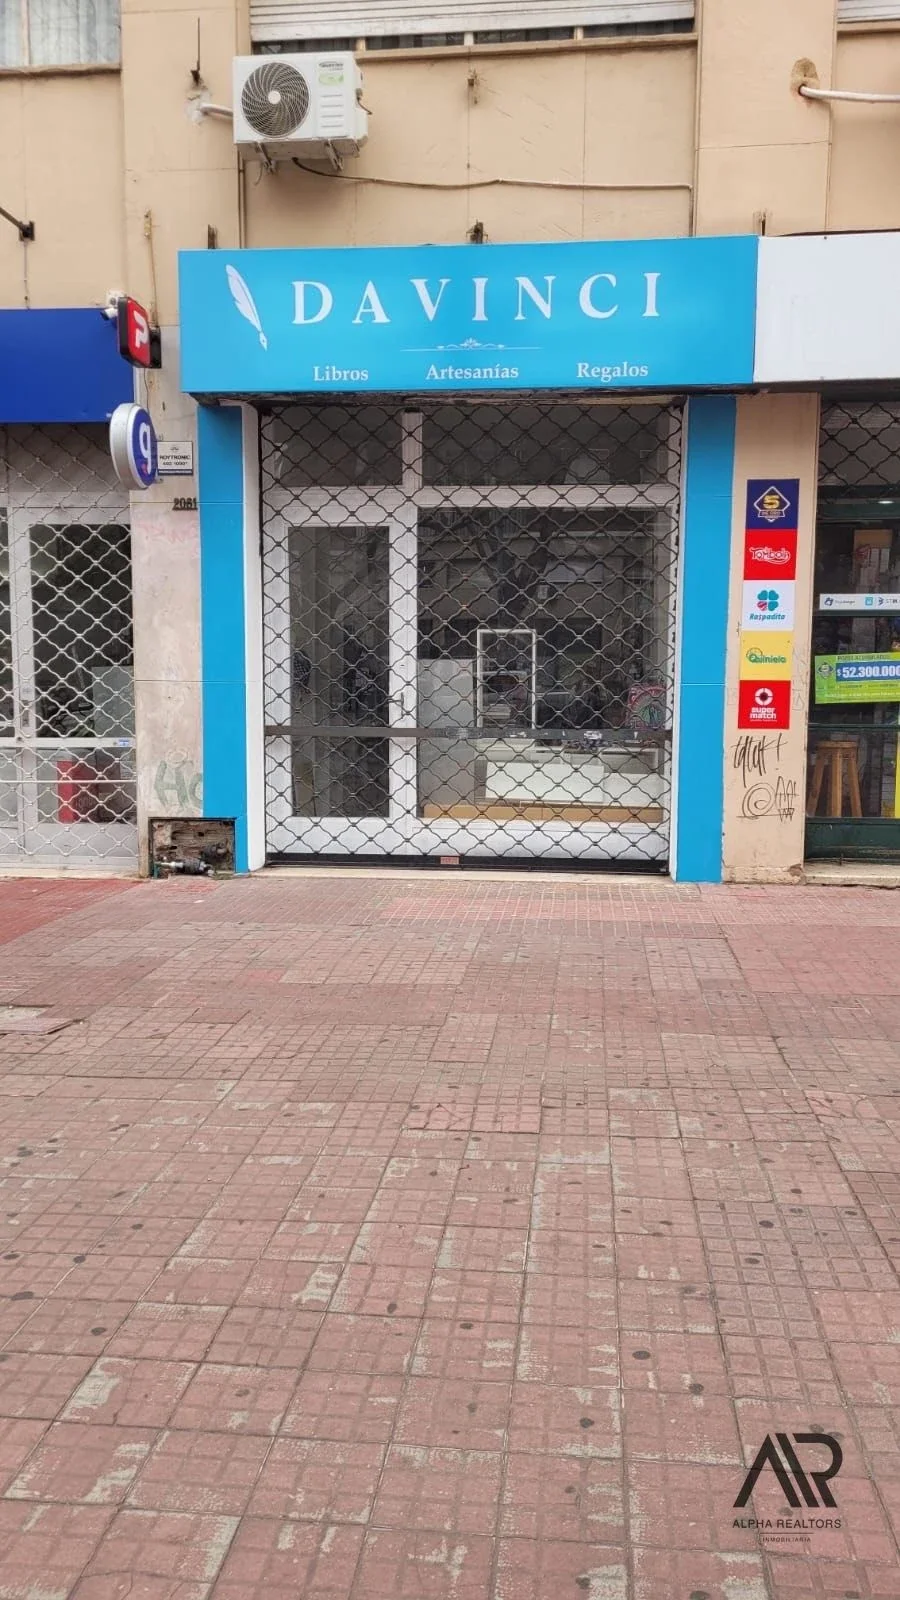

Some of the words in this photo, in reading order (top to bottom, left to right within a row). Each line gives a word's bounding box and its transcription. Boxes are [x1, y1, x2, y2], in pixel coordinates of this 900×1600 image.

[291, 272, 662, 325] DAVINCI
[313, 365, 369, 381] Libros
[425, 362, 519, 380] Artesanías
[577, 360, 648, 381] Regalos
[751, 706, 776, 714] super
